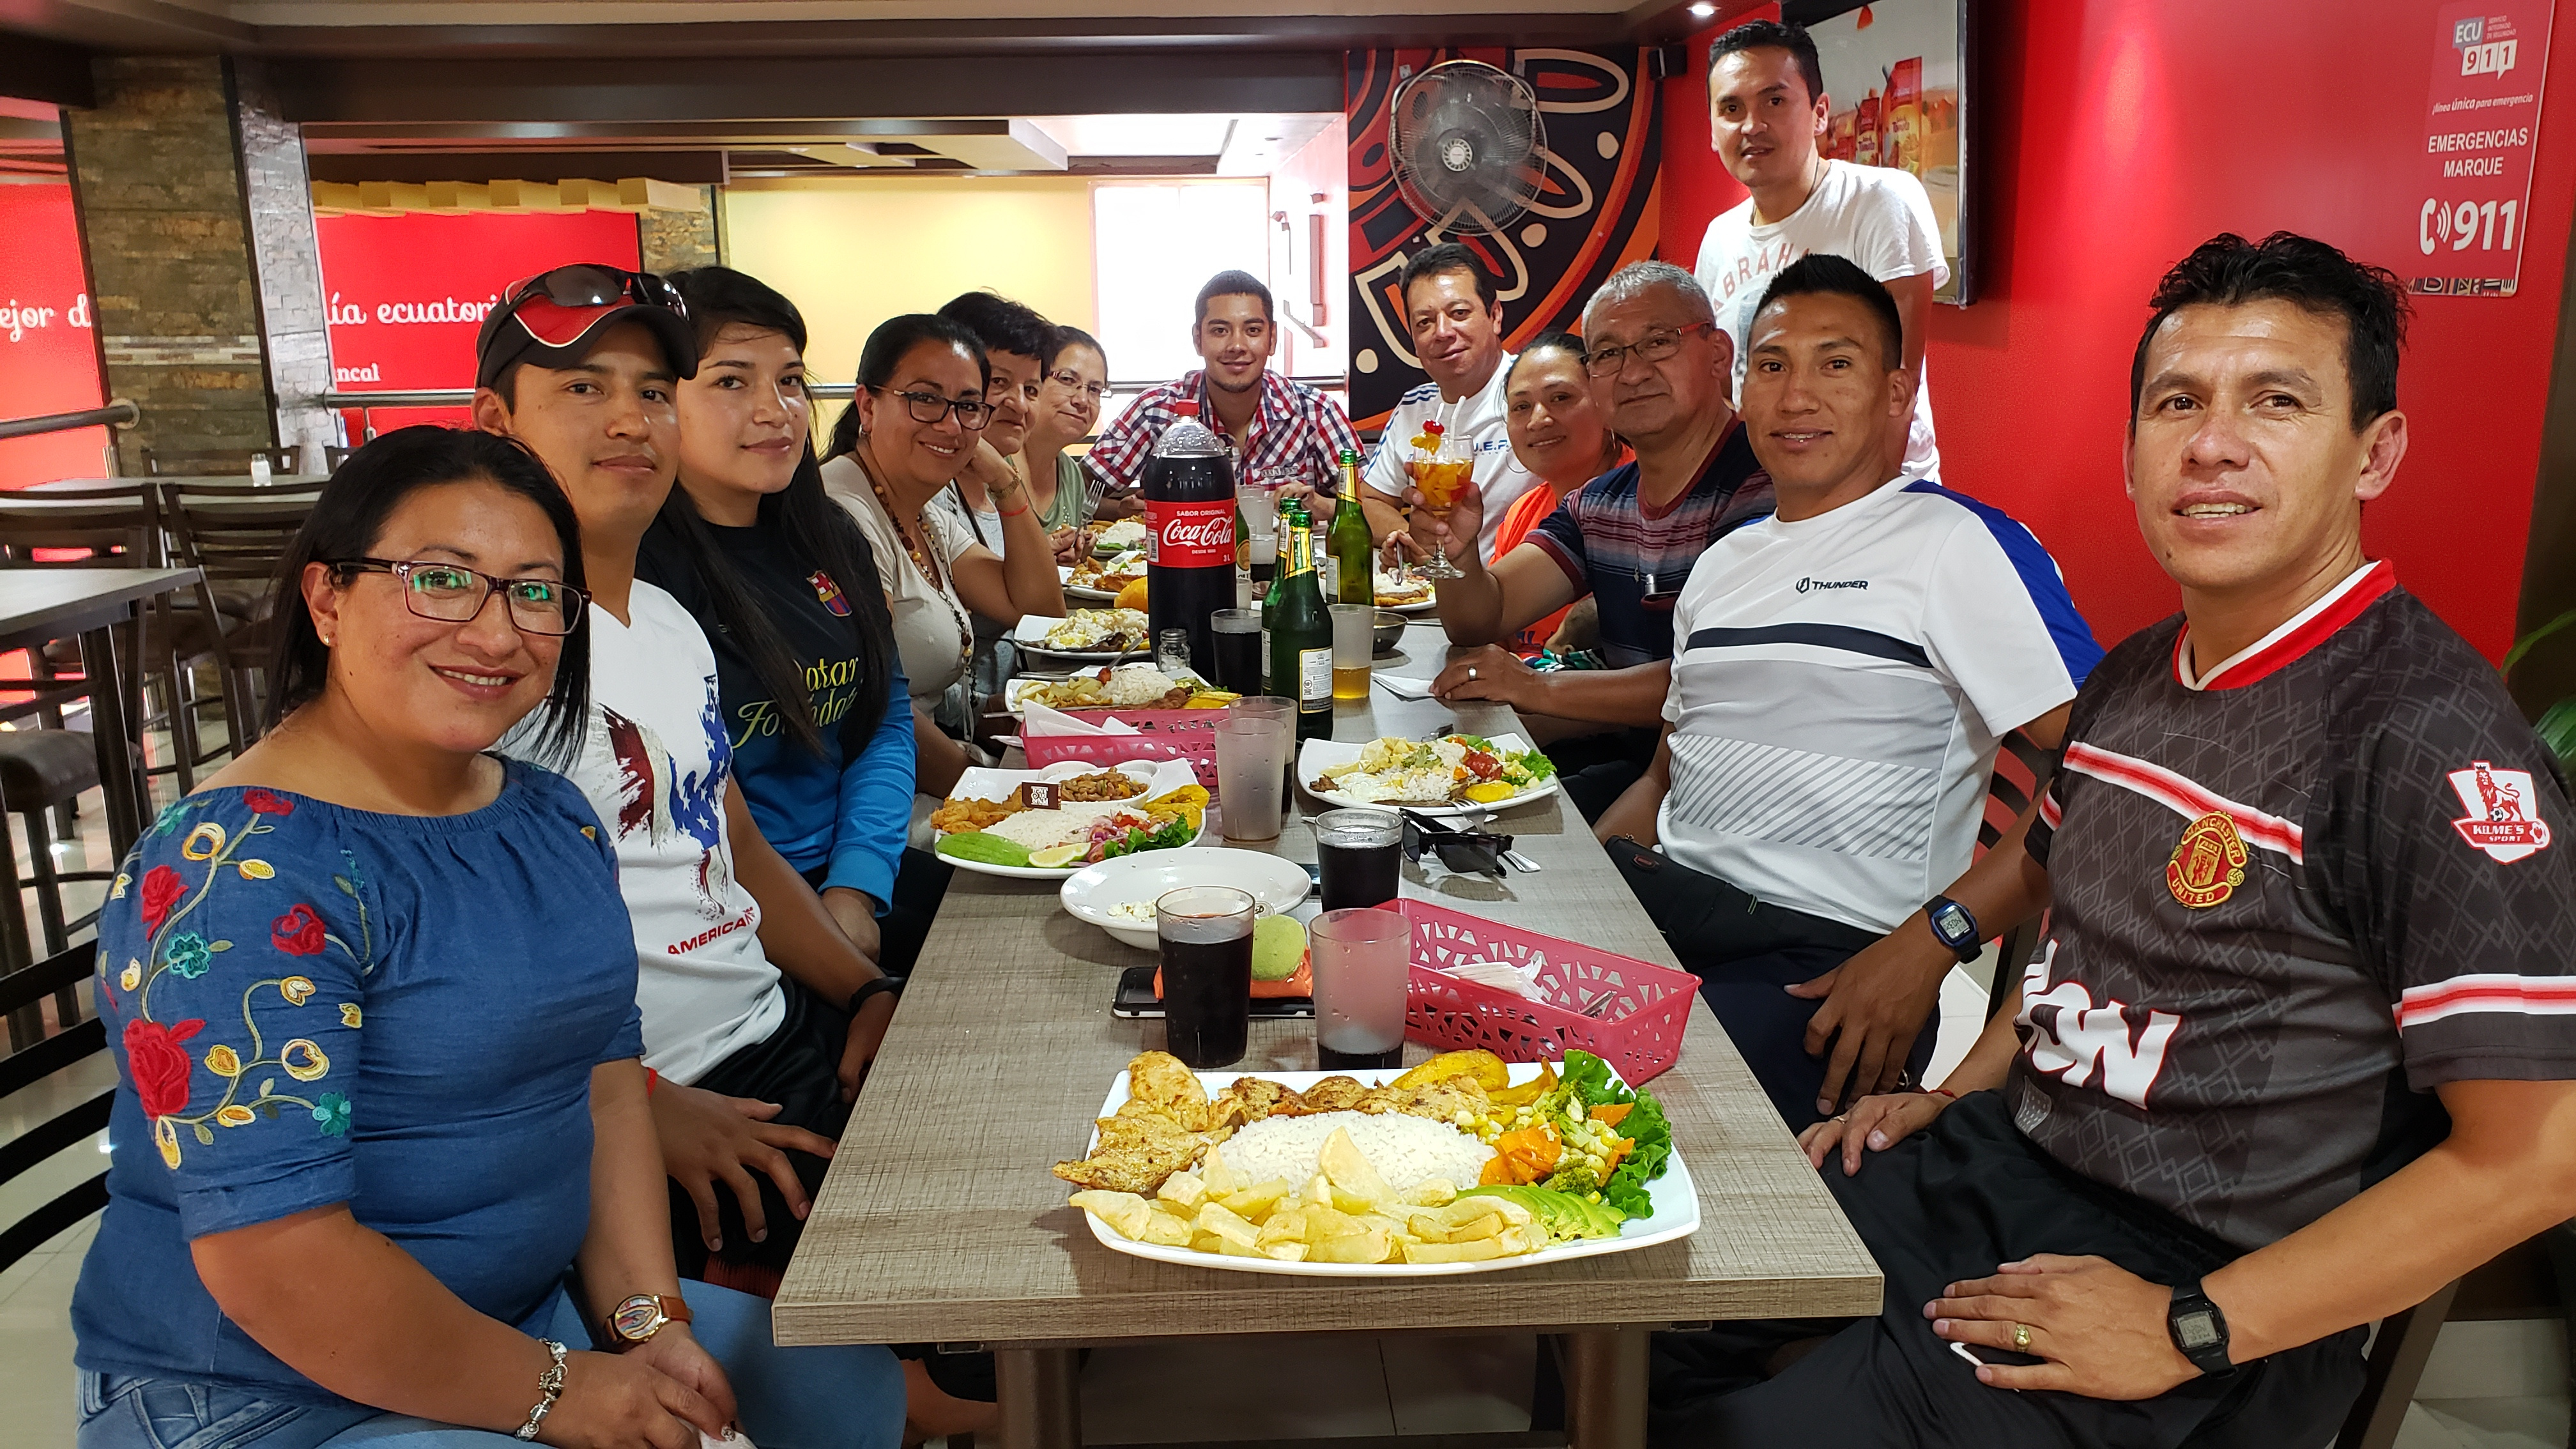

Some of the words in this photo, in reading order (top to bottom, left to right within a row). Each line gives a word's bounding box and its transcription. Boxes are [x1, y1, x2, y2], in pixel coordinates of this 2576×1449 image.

[2455, 21, 2482, 43] ECU
[2467, 45, 2510, 70] 911
[2451, 96, 2476, 111] única
[2475, 99, 2492, 111] para
[2428, 127, 2529, 153] EMERGENCIAS
[2443, 157, 2504, 178] MARQUE
[2453, 199, 2518, 252] 911
[1163, 516, 1233, 547] Coca-Cola
[1812, 580, 1869, 590] THUNDER
[2187, 818, 2241, 860] MANCHESTER
[2172, 877, 2214, 903] UNITED
